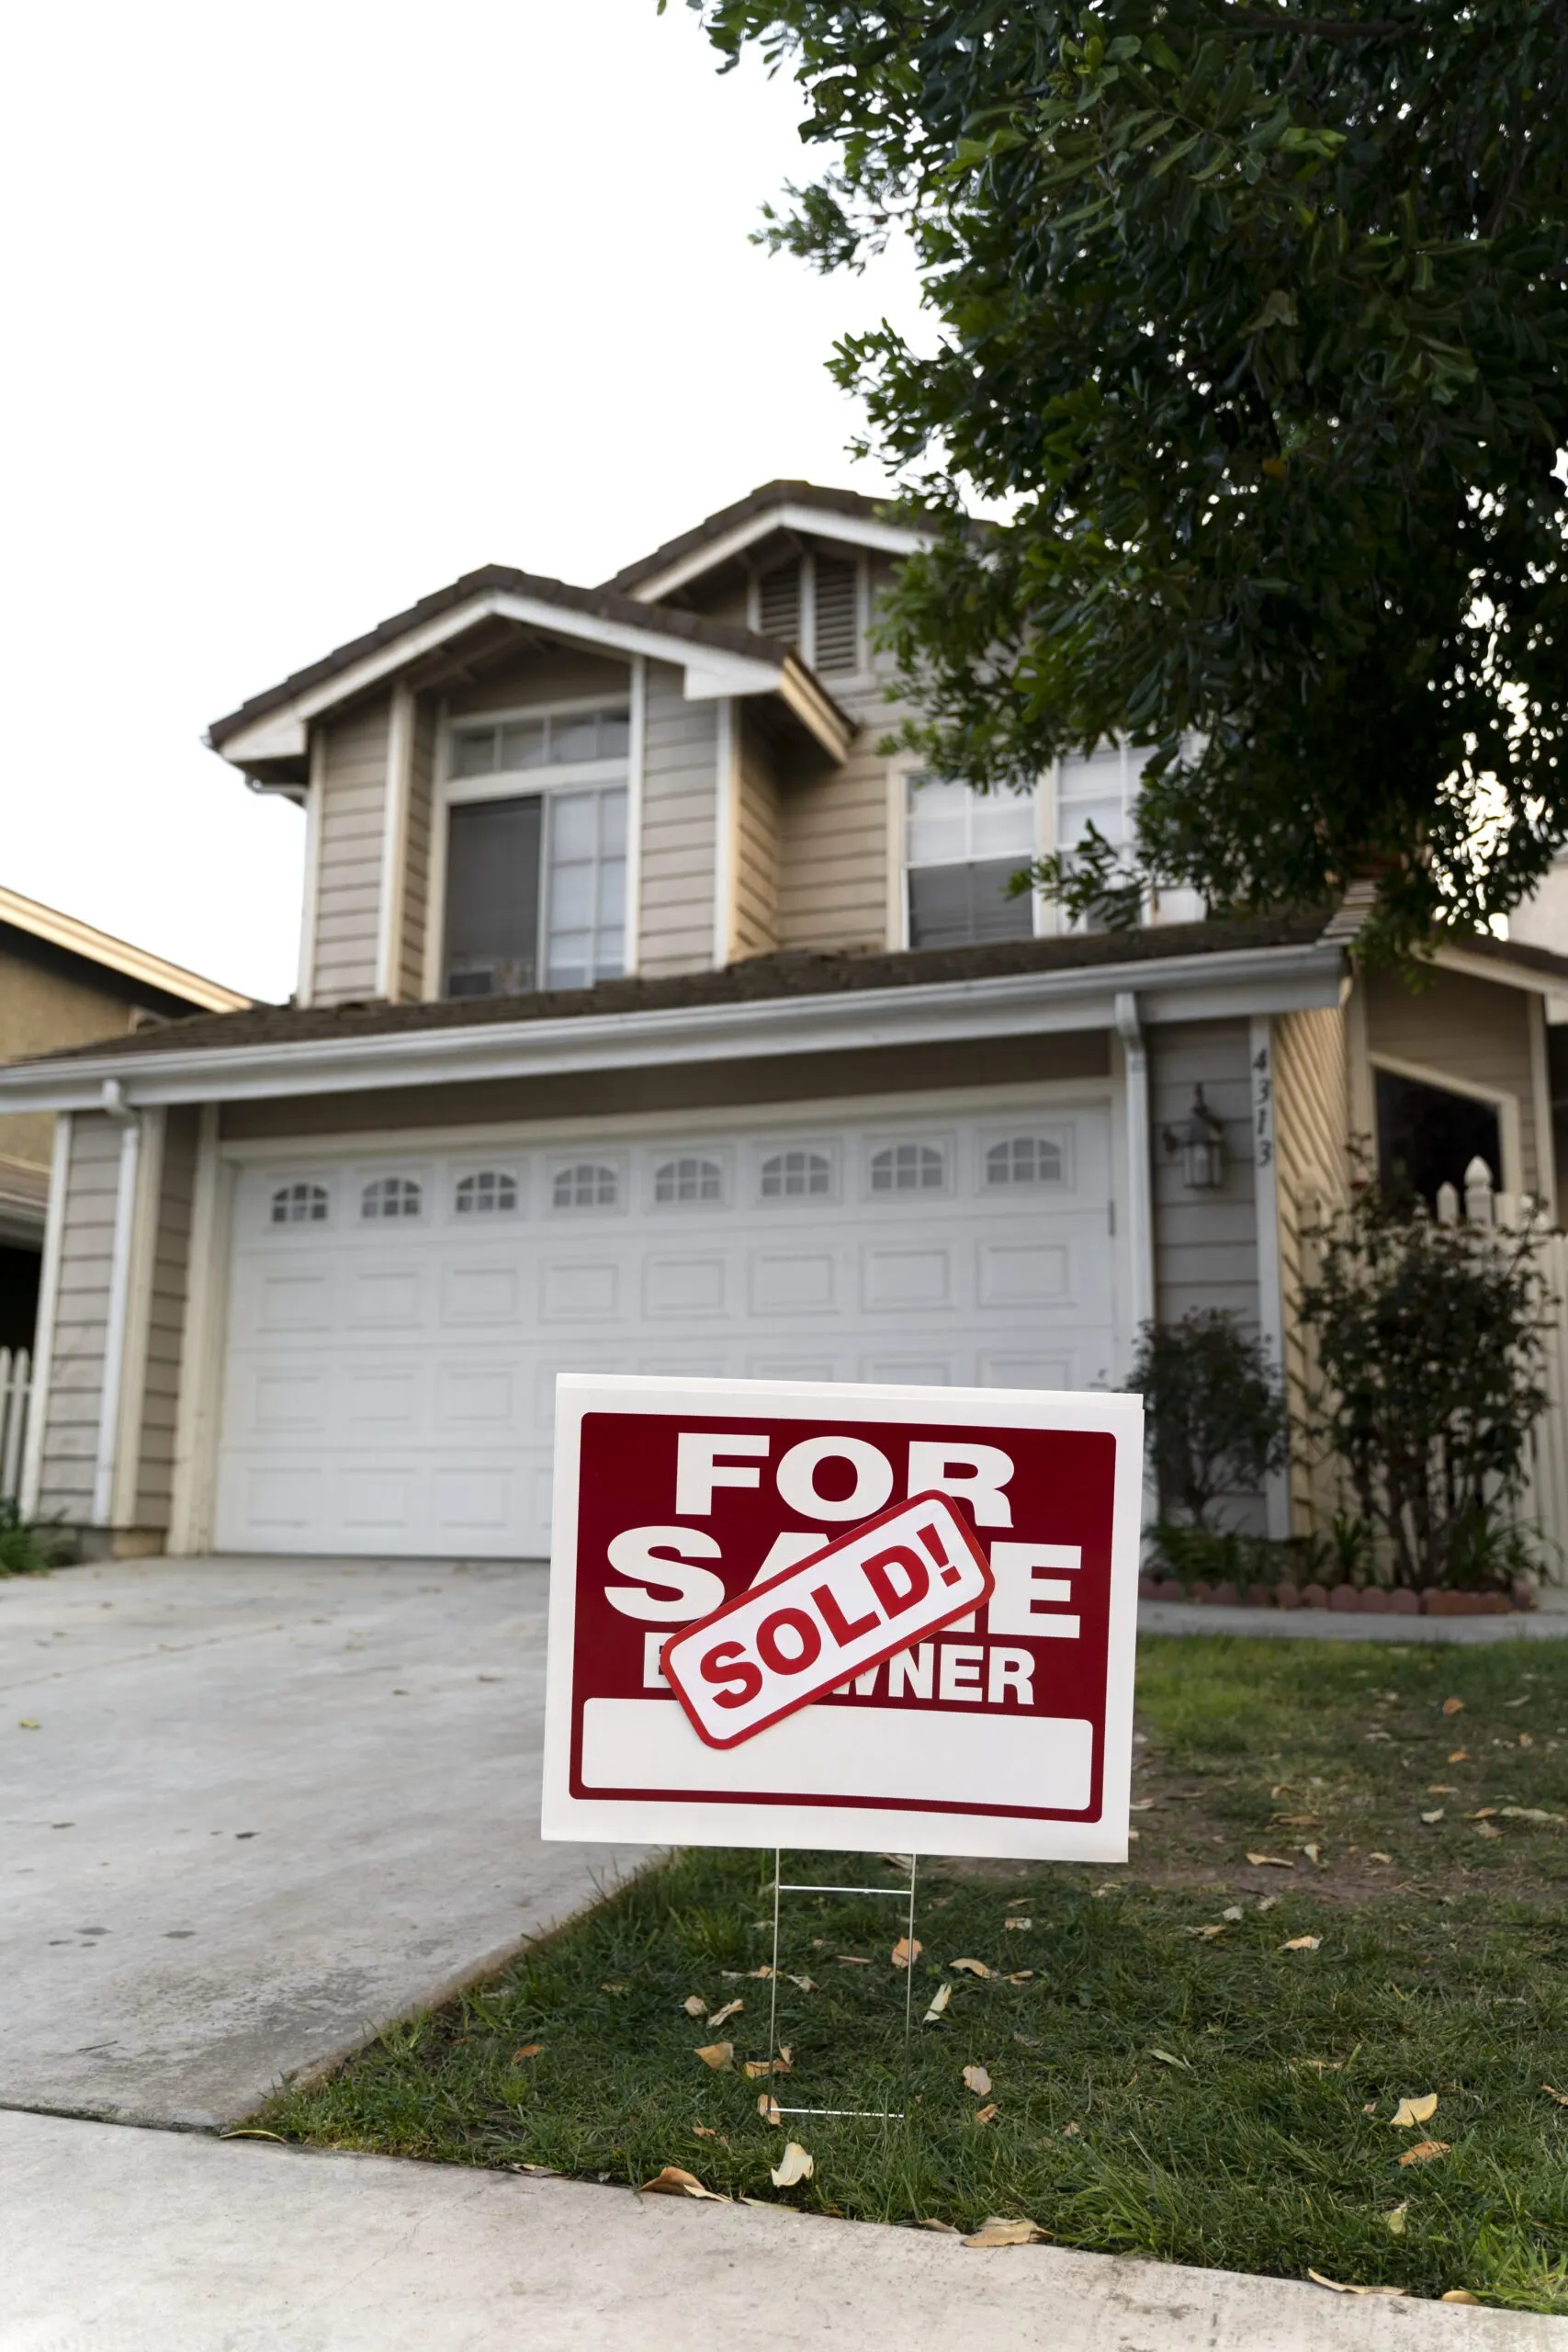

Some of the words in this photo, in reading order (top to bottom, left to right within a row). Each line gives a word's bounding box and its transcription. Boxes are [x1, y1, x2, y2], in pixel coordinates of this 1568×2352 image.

[1253, 1046, 1273, 1168] 4313
[675, 1432, 1015, 1528] FOR
[604, 1525, 1082, 1639] SE
[700, 1522, 962, 1709] SOLD!
[831, 1642, 1035, 1705] NER
